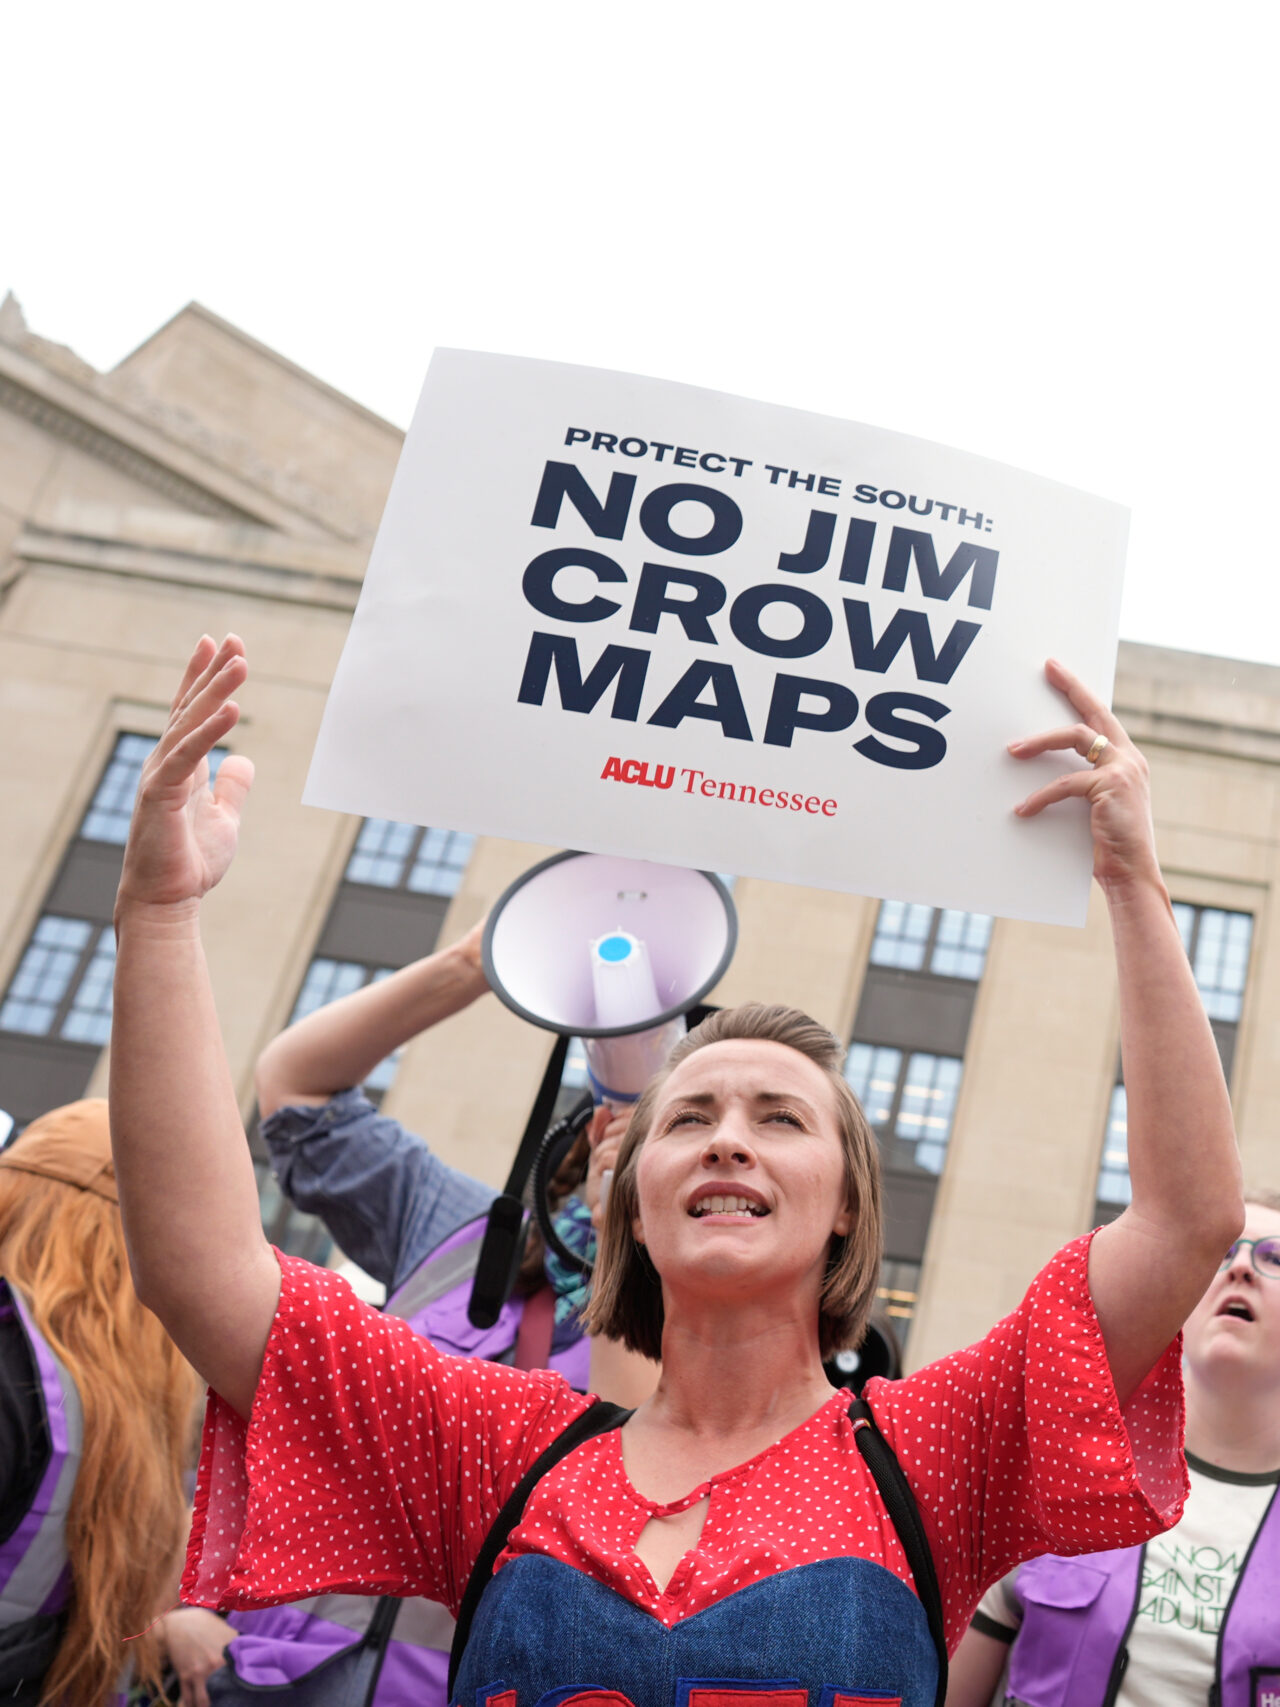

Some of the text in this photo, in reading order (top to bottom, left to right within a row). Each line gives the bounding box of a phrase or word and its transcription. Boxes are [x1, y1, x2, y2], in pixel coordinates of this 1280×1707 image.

[530, 460, 1000, 611] NO JIM
[565, 427, 994, 533] PROTECT THE SOUTH:
[522, 548, 983, 685] CROW
[517, 631, 952, 771] MAPS
[600, 756, 839, 817] ACLU Tennessee
